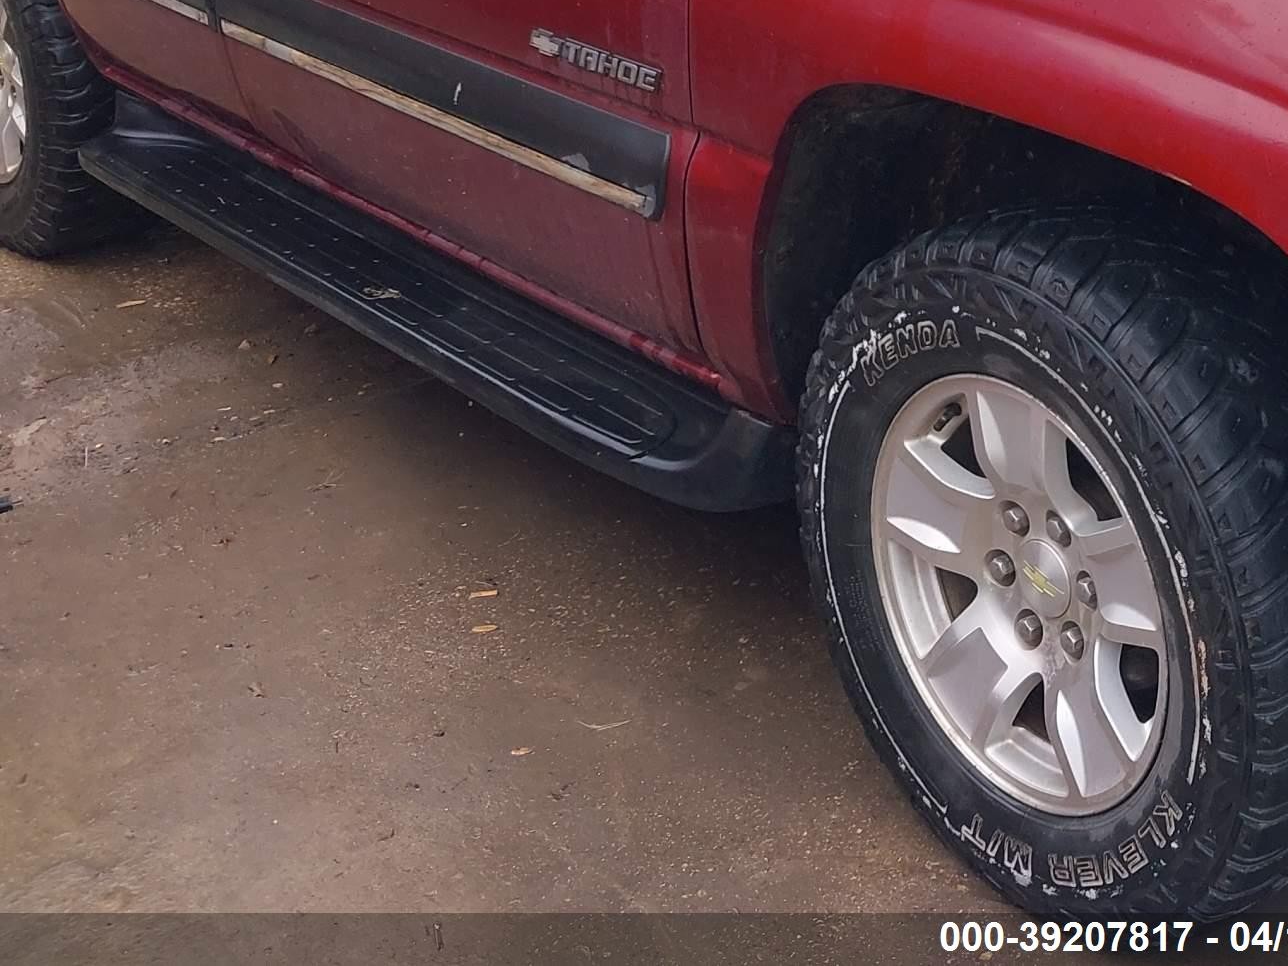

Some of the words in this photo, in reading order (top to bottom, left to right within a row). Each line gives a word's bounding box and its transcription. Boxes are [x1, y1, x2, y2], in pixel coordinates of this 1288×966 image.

[562, 38, 664, 92] TAHOE
[860, 319, 961, 386] KENDA
[1047, 790, 1183, 888] KLEVER
